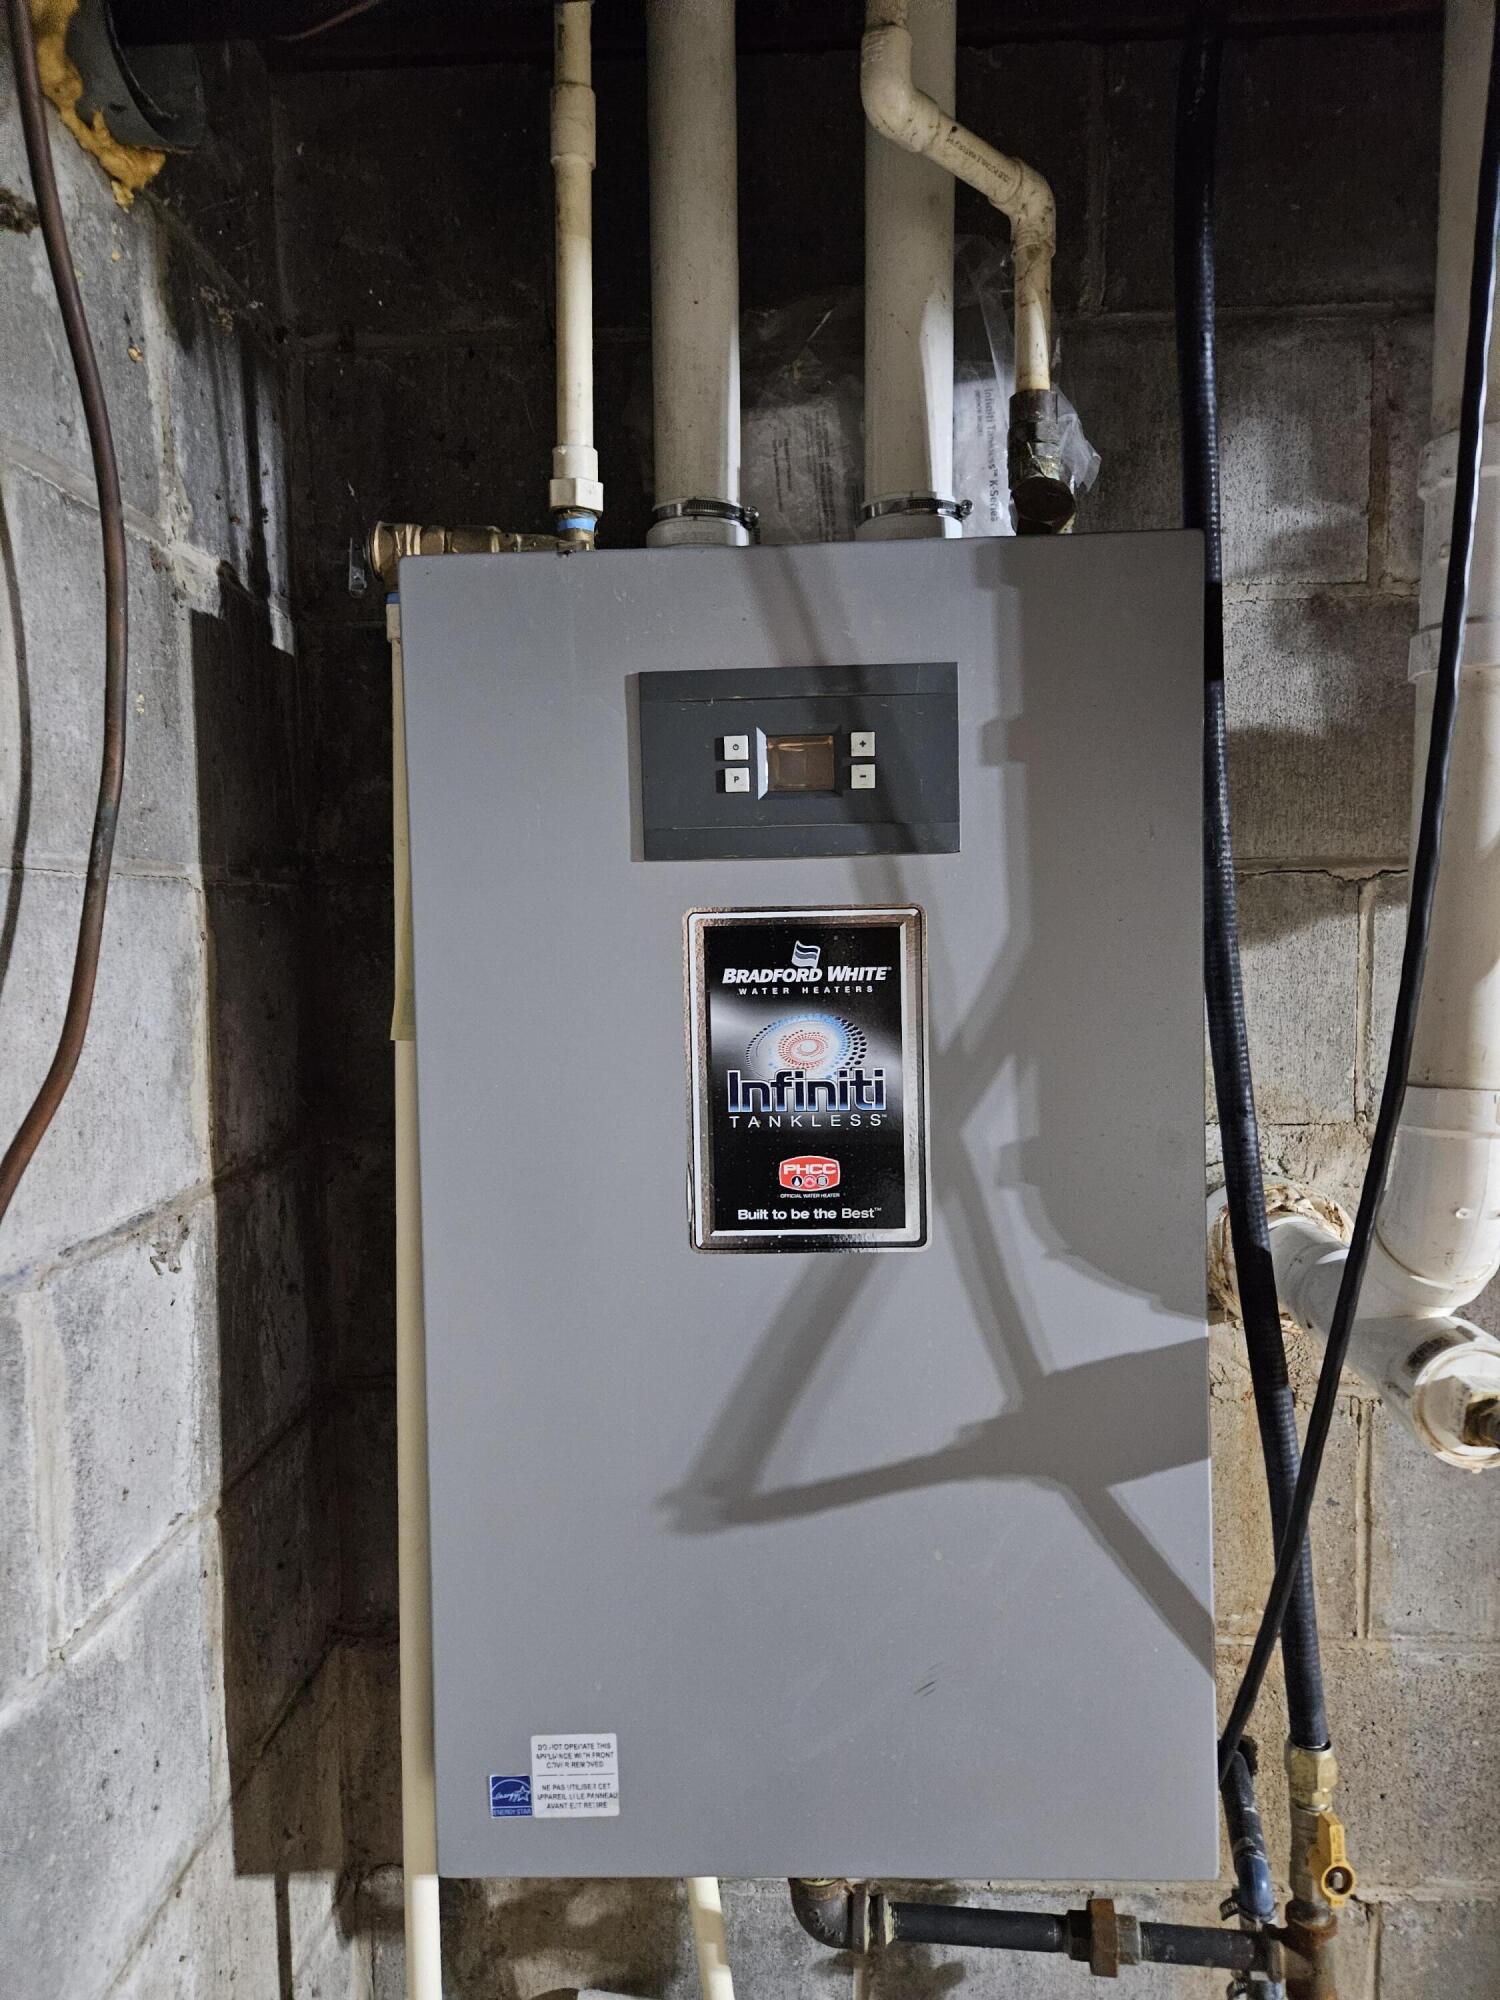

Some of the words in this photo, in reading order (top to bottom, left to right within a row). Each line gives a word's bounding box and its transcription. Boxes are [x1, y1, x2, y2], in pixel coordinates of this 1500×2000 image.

[722, 967, 823, 984] BRADFORD
[738, 987, 790, 995] WATER
[801, 985, 873, 994] HEATERS
[727, 1067, 887, 1113] Infiniti
[783, 1163, 837, 1175] PHCC
[737, 1209, 769, 1220] Built
[772, 1209, 787, 1220] to
[790, 1208, 810, 1219] be
[813, 1208, 837, 1219] the
